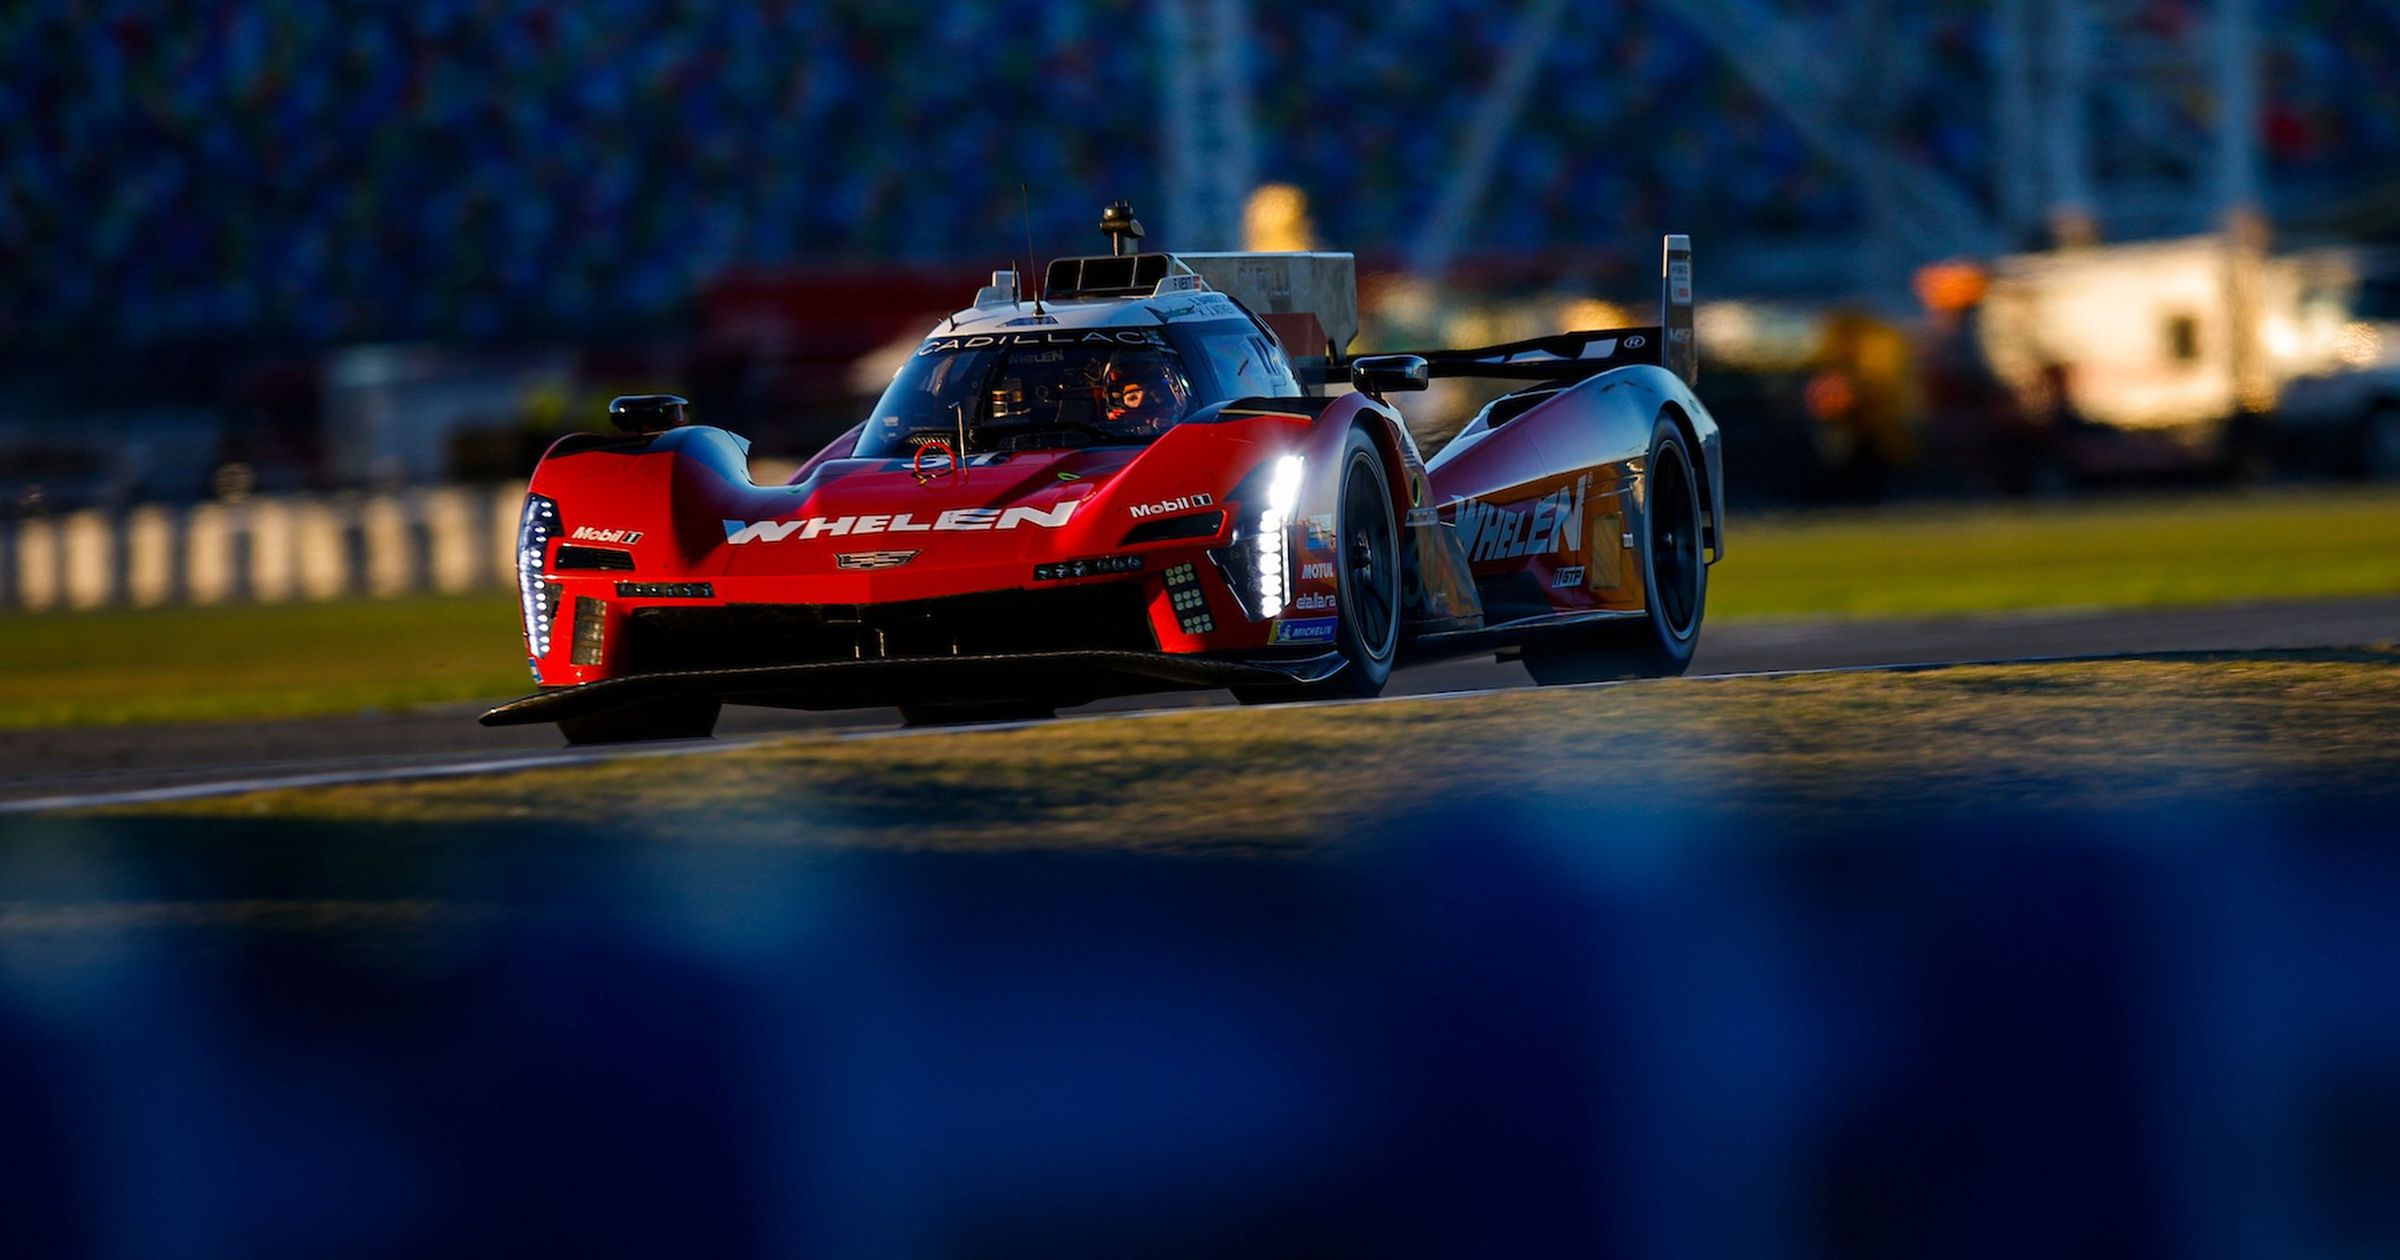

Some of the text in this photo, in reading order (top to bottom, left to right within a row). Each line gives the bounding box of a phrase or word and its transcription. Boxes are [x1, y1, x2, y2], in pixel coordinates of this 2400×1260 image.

[919, 332, 1146, 356] CADILLAC
[1130, 497, 1189, 518] Mobil
[722, 500, 1080, 545] WHELEN
[1450, 474, 1587, 562] WHELEN
[572, 526, 625, 543] Mobil
[1302, 562, 1334, 580] MOTUL
[1296, 592, 1336, 610] dallara
[1292, 624, 1332, 637] MICHELIN
